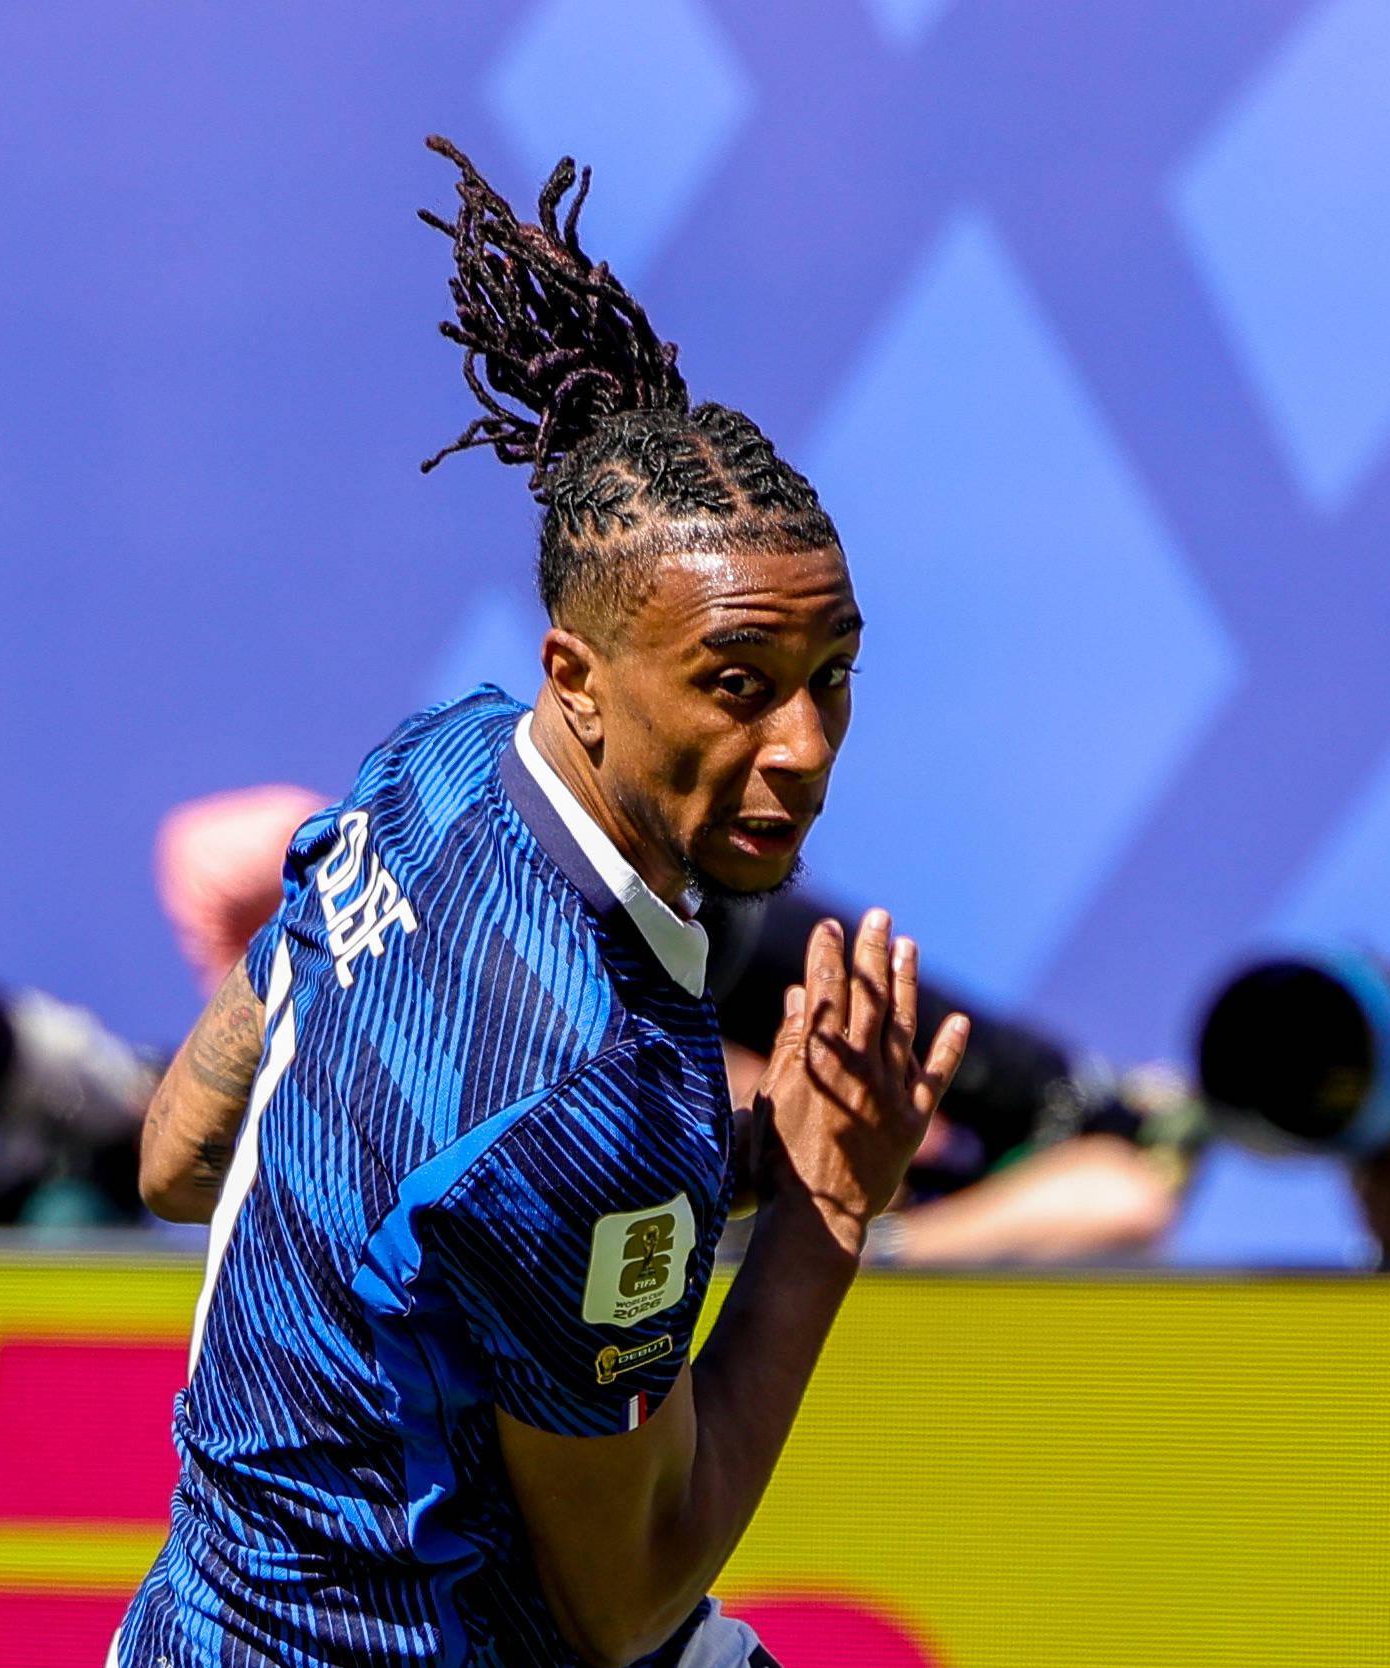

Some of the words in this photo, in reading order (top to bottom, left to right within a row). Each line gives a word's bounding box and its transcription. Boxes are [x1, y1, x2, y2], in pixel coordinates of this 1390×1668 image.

[634, 1278, 657, 1291] FIFA
[613, 1298, 663, 1320] 2026
[619, 1341, 666, 1364] DEBUT
